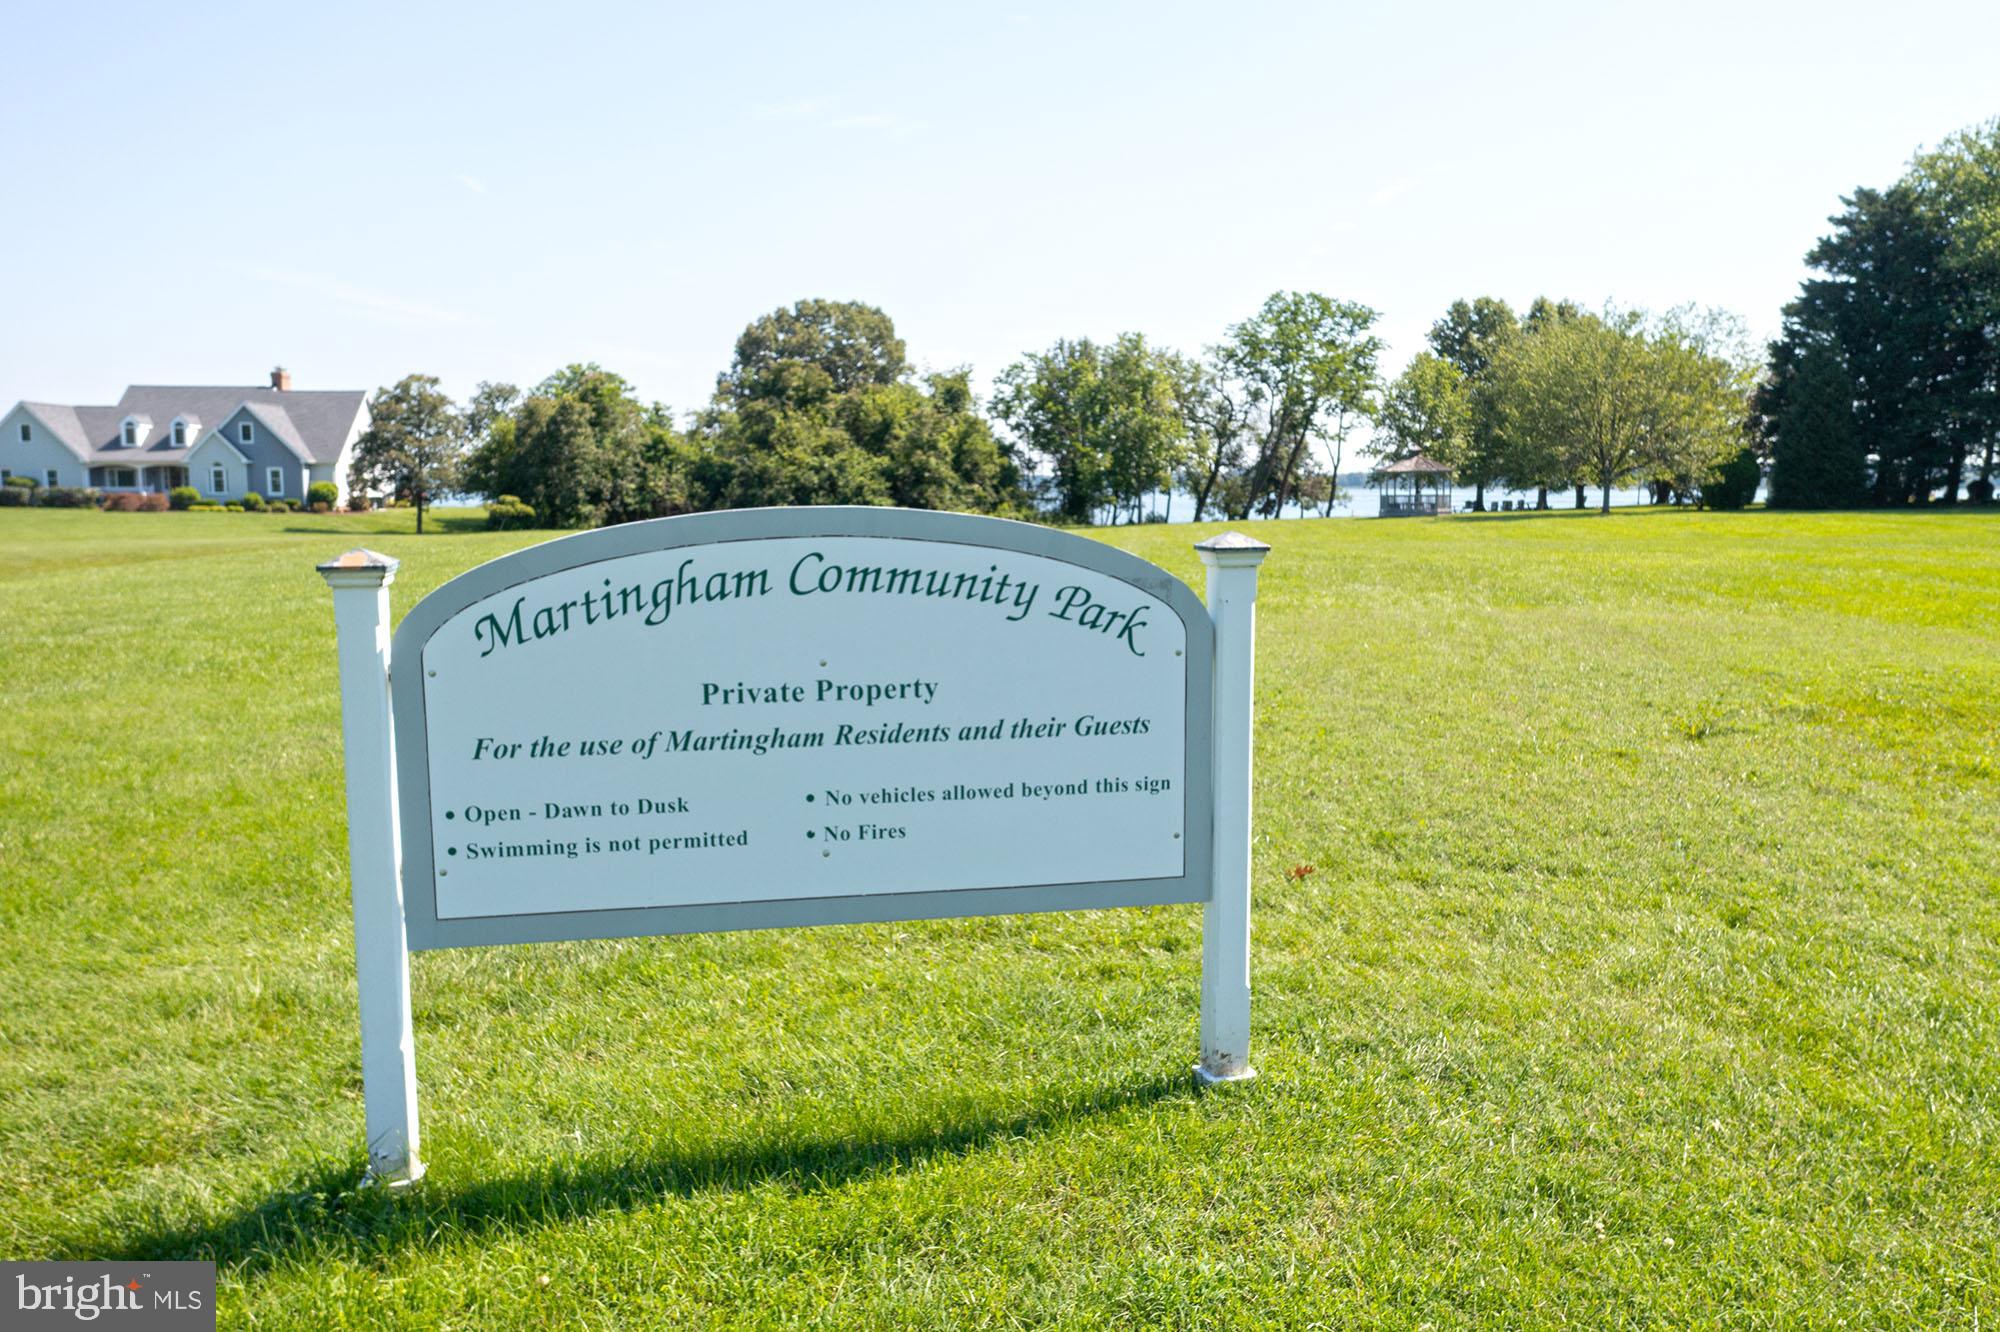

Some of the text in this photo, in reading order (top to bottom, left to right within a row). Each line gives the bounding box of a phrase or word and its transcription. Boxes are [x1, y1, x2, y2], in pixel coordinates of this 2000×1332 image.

[473, 551, 1152, 659] Martingham Community Park
[701, 678, 939, 707] Private Property
[471, 714, 1151, 761] For the use of Martingham Residents and their Guests
[824, 775, 1171, 807] No vehicles allowed beyond this sign
[464, 805, 522, 827] Open
[544, 802, 603, 820] Dawn
[609, 800, 630, 817] to
[637, 796, 690, 816] Dusk
[466, 829, 749, 860] Swimming is not permitted
[823, 823, 907, 843] No Fires
